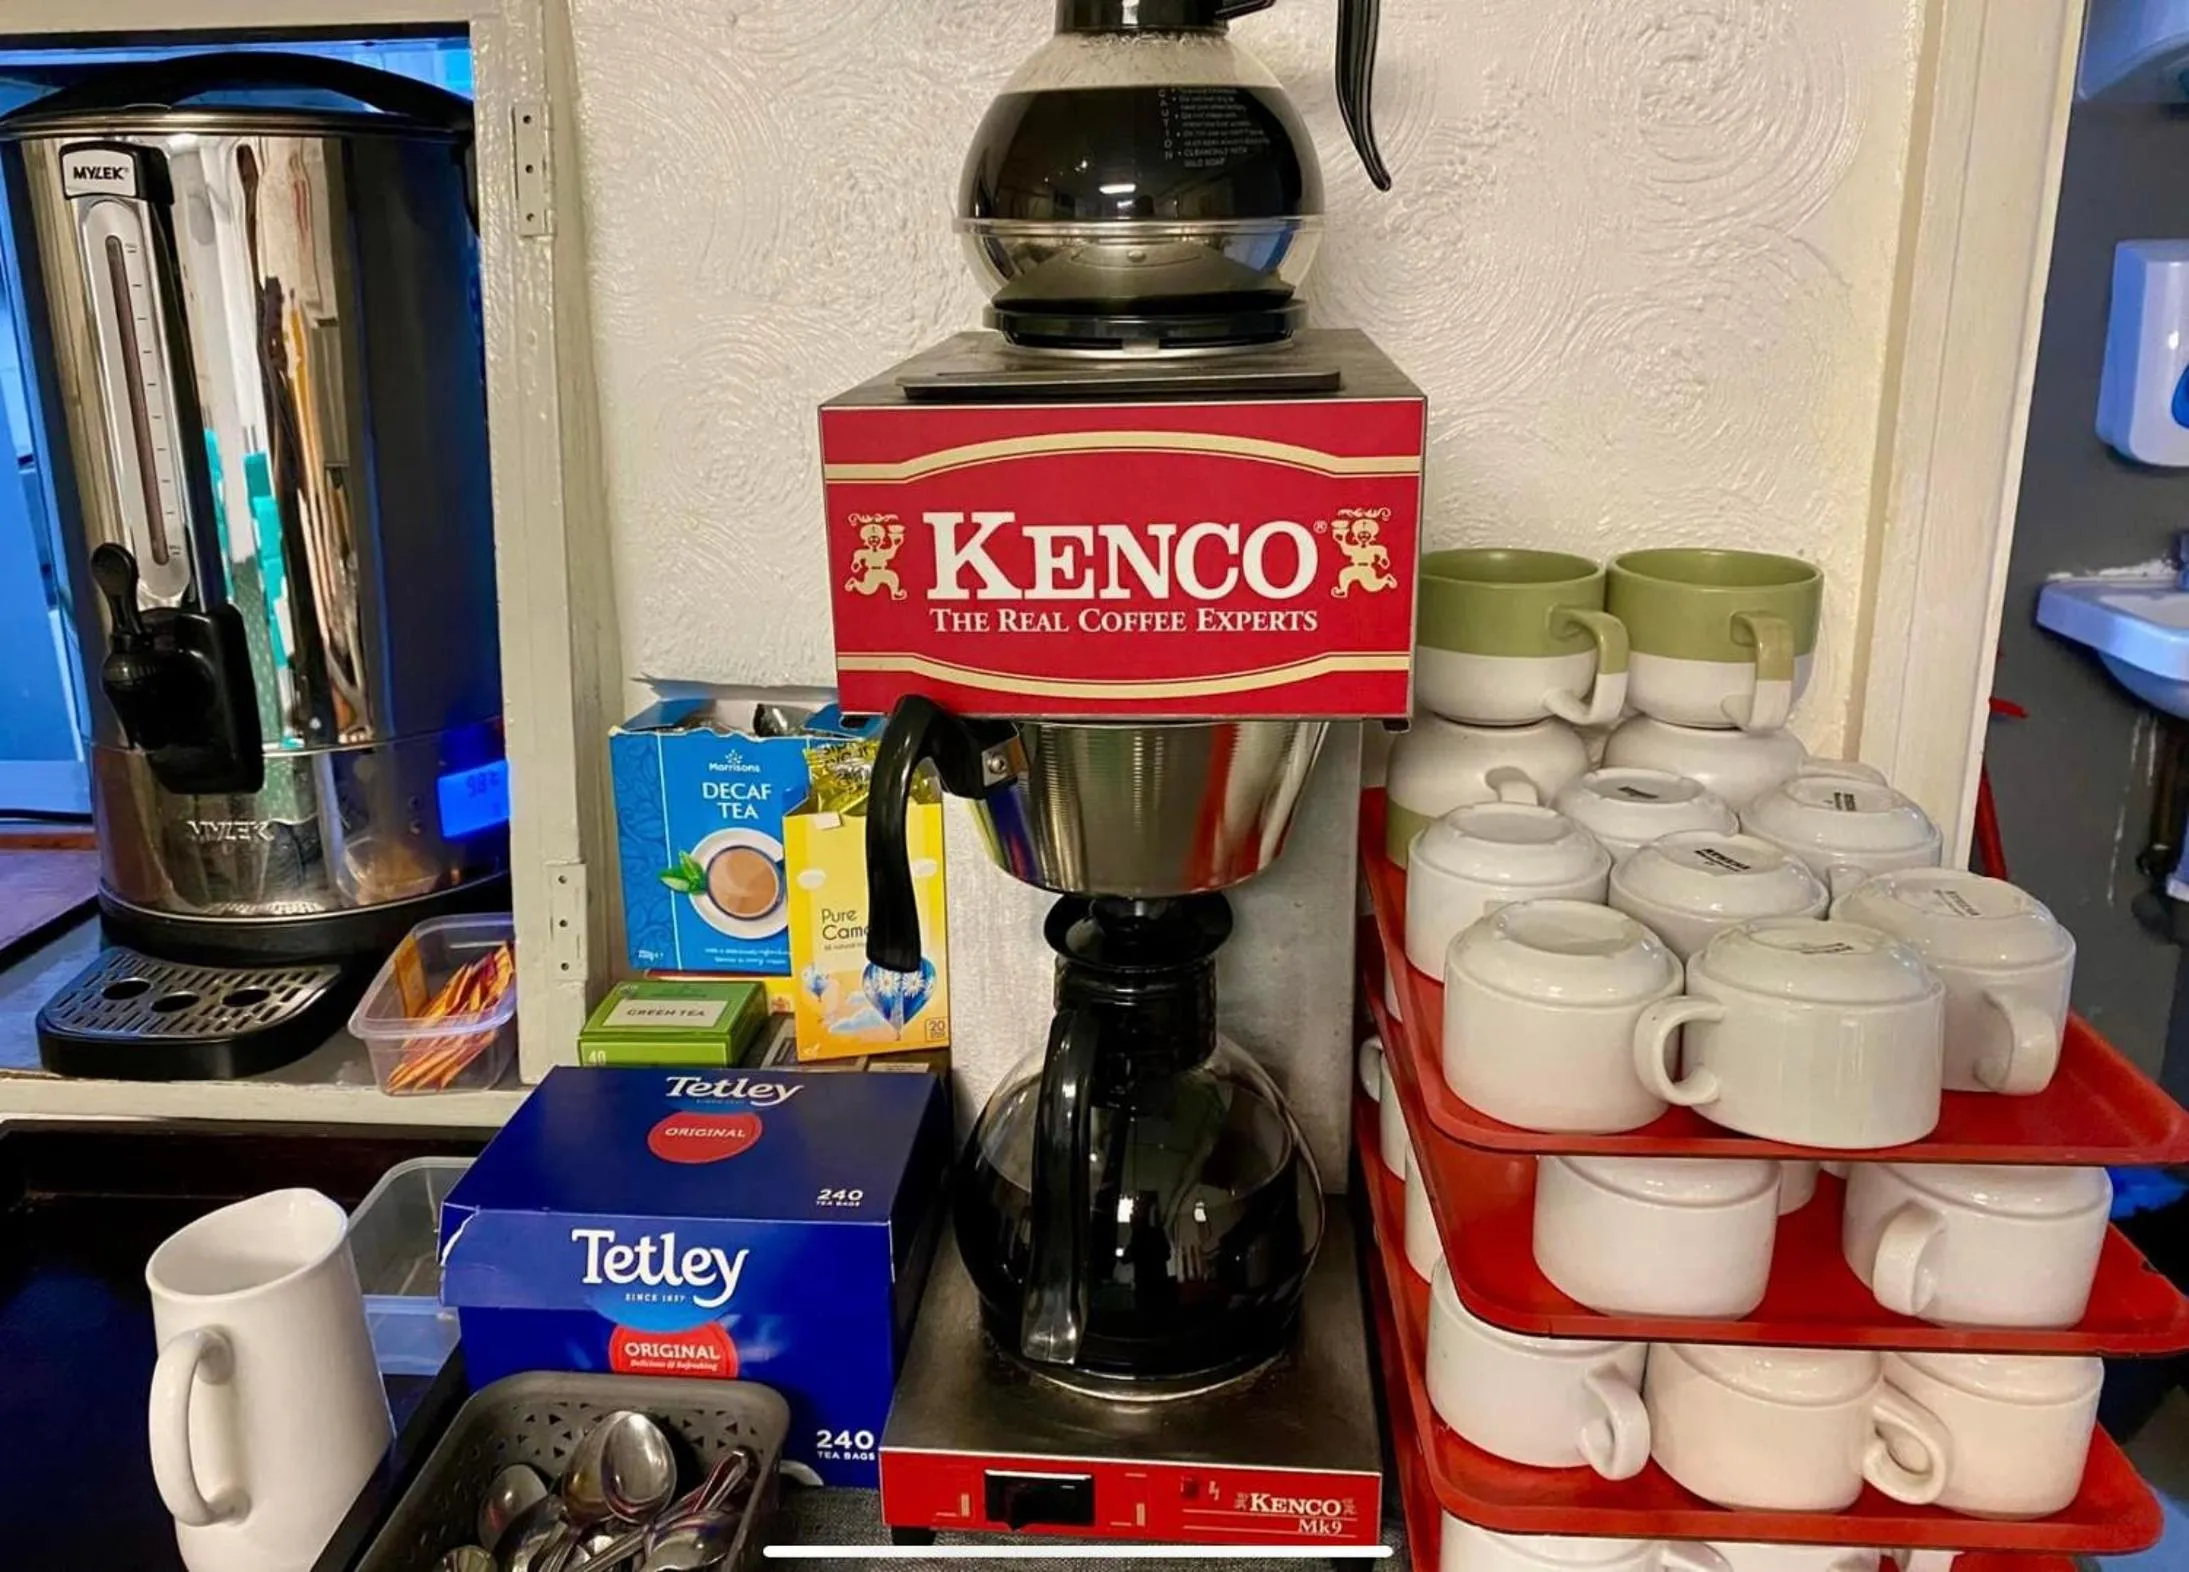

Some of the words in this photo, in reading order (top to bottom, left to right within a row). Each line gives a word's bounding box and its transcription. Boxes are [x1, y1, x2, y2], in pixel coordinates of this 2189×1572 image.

[73, 166, 124, 180] MYLEK
[930, 608, 990, 632] THE
[998, 608, 1069, 632] REAL
[1078, 608, 1187, 632] COFFEE
[1196, 608, 1318, 632] EXPERTS
[708, 763, 760, 773] Morrisons
[702, 782, 772, 800] DECAF
[717, 802, 760, 819] TEA
[821, 908, 857, 924] Pure
[627, 1008, 676, 1017] GREEN
[680, 1008, 706, 1017] TEA
[665, 1076, 805, 1107] Tetley
[665, 1127, 746, 1139] ORIGINAL
[817, 1188, 864, 1201] 240
[571, 1228, 750, 1309] Tetley
[624, 1341, 722, 1361] ORIGINAL
[817, 1429, 875, 1450] 240
[817, 1450, 840, 1460] TEA
[843, 1451, 876, 1461] BAGS
[1250, 1492, 1342, 1517] KENCO
[1299, 1518, 1343, 1536] Mk9
